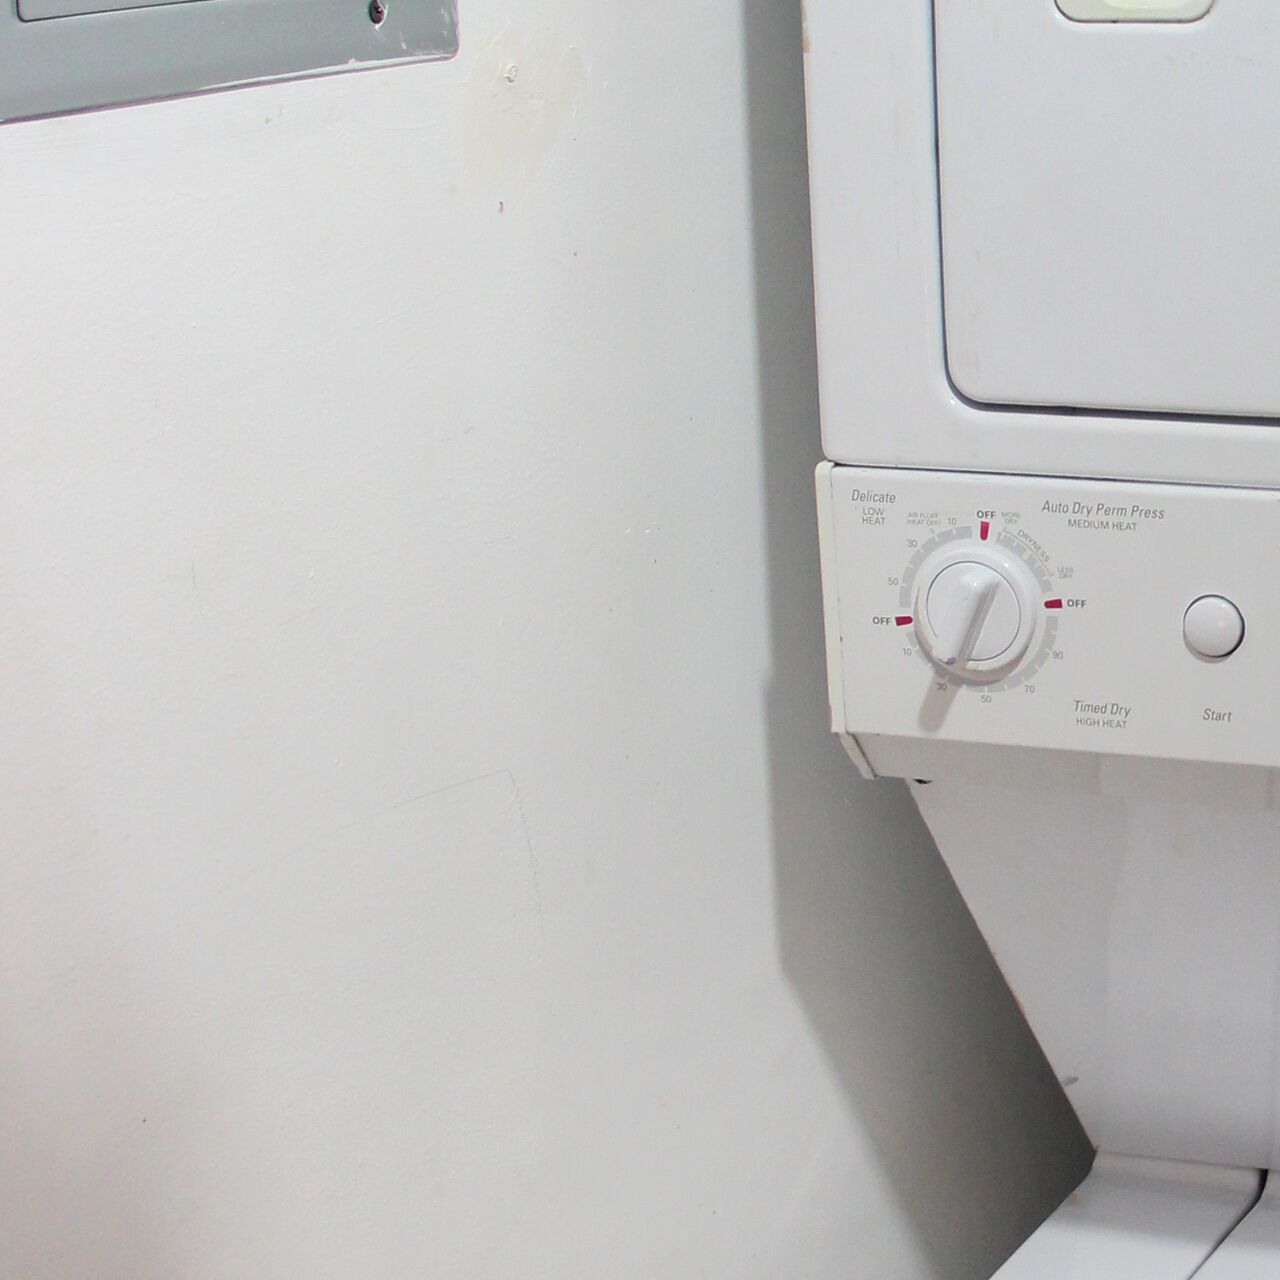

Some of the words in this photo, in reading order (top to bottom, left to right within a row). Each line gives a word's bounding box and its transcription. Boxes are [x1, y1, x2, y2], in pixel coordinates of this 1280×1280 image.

[851, 488, 897, 504] Delicate
[862, 507, 885, 517] LOW
[976, 509, 997, 519] OFF
[1041, 500, 1069, 515] Auto
[1072, 501, 1093, 518] Dry
[1096, 503, 1127, 518] Perm
[1131, 505, 1165, 520] Press
[861, 517, 886, 526] HEAT
[947, 517, 957, 526] 10
[1068, 519, 1110, 531] MEDIUM
[1112, 521, 1138, 531] HEAT
[907, 539, 918, 549] 30
[1017, 529, 1050, 563] DRYNESS
[888, 576, 899, 587] 50
[1066, 599, 1087, 609] OFF
[872, 616, 892, 626] OFF
[902, 647, 912, 657] 10
[1052, 650, 1064, 660] 90
[1024, 684, 1035, 694] 70
[981, 694, 992, 704] 50
[1074, 700, 1108, 715] Timed
[1110, 702, 1132, 719] Dry
[1203, 707, 1233, 723] Start
[1076, 717, 1101, 728] HIGH
[1102, 719, 1128, 730] HEAT
